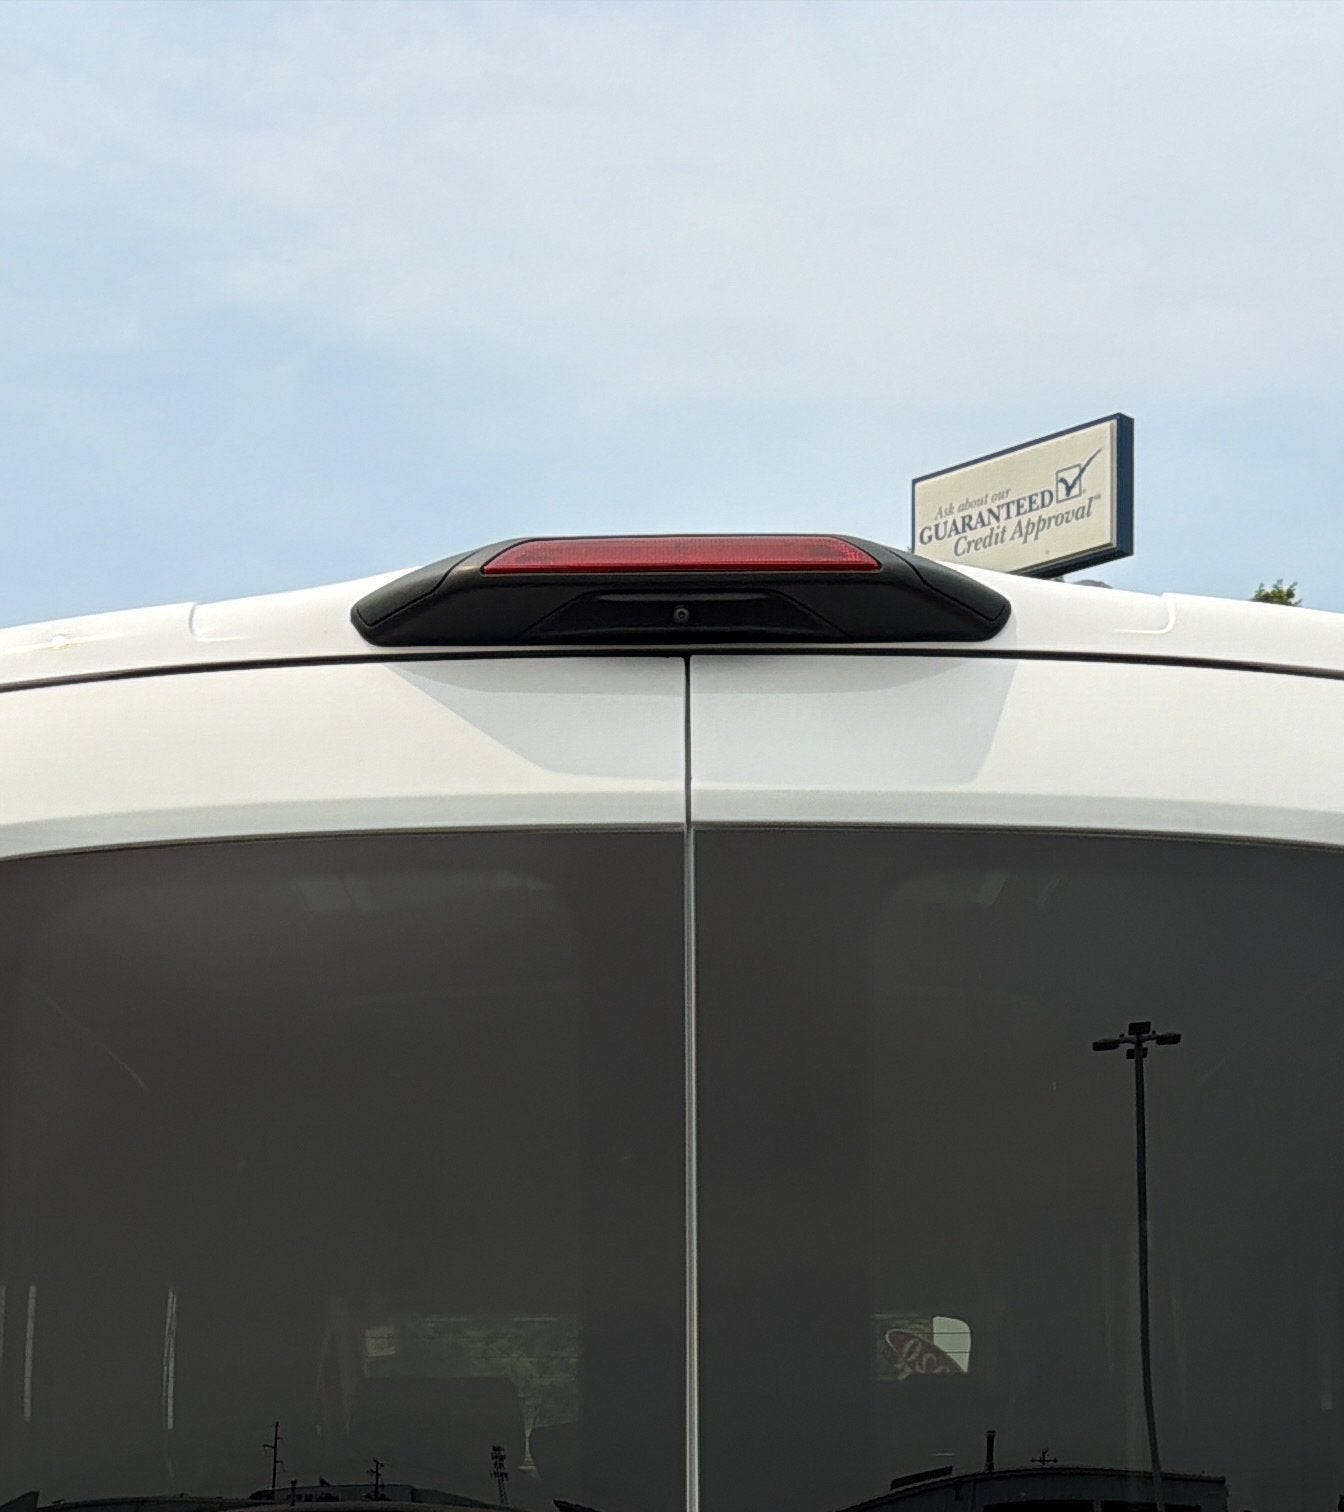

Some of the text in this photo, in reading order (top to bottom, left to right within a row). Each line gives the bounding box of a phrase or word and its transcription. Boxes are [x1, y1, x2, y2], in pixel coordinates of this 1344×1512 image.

[919, 489, 1054, 546] GUARANTEED
[934, 488, 1011, 520] Ask about our
[953, 497, 1093, 557] Credit Approval
